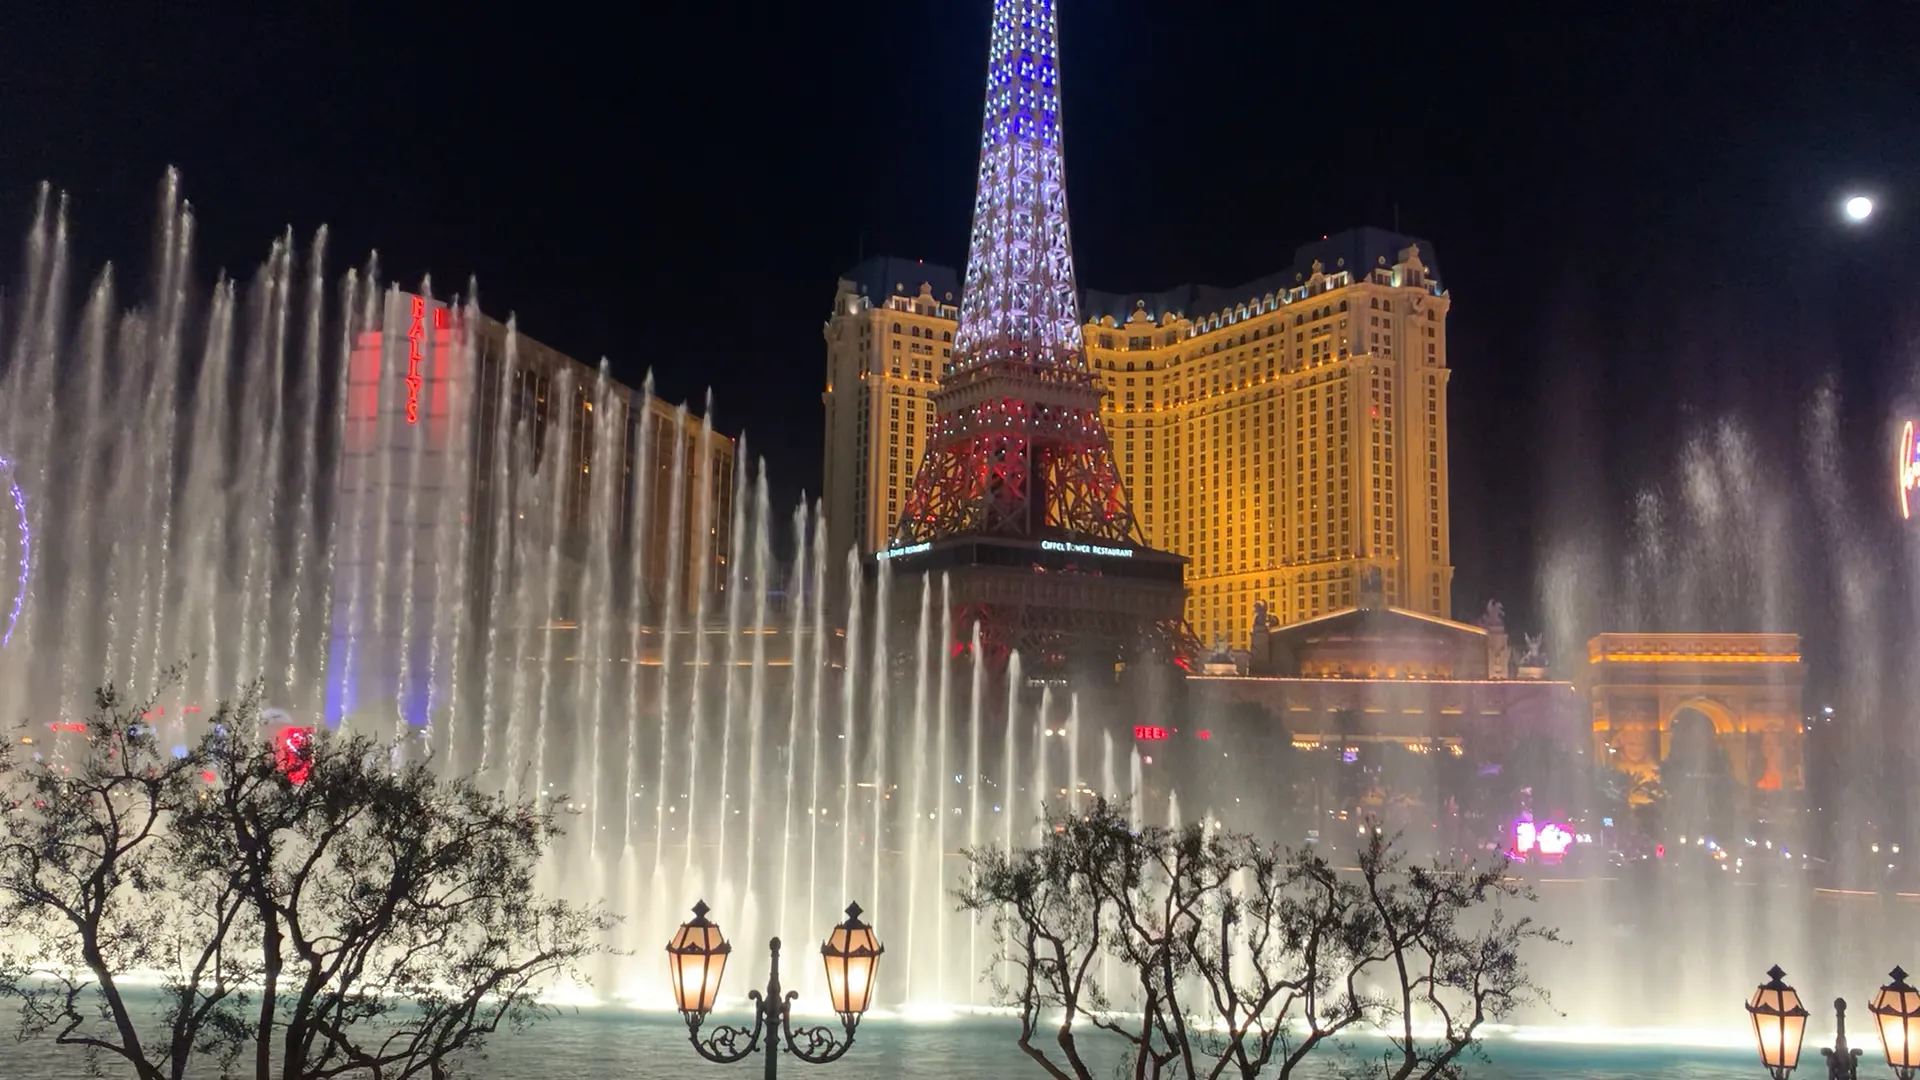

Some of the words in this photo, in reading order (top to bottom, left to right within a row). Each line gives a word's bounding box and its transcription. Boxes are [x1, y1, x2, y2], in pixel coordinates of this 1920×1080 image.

[1041, 540, 1065, 552] EIFFEL
[1065, 542, 1090, 553] TOWER
[1092, 545, 1133, 558] RESTAURANT
